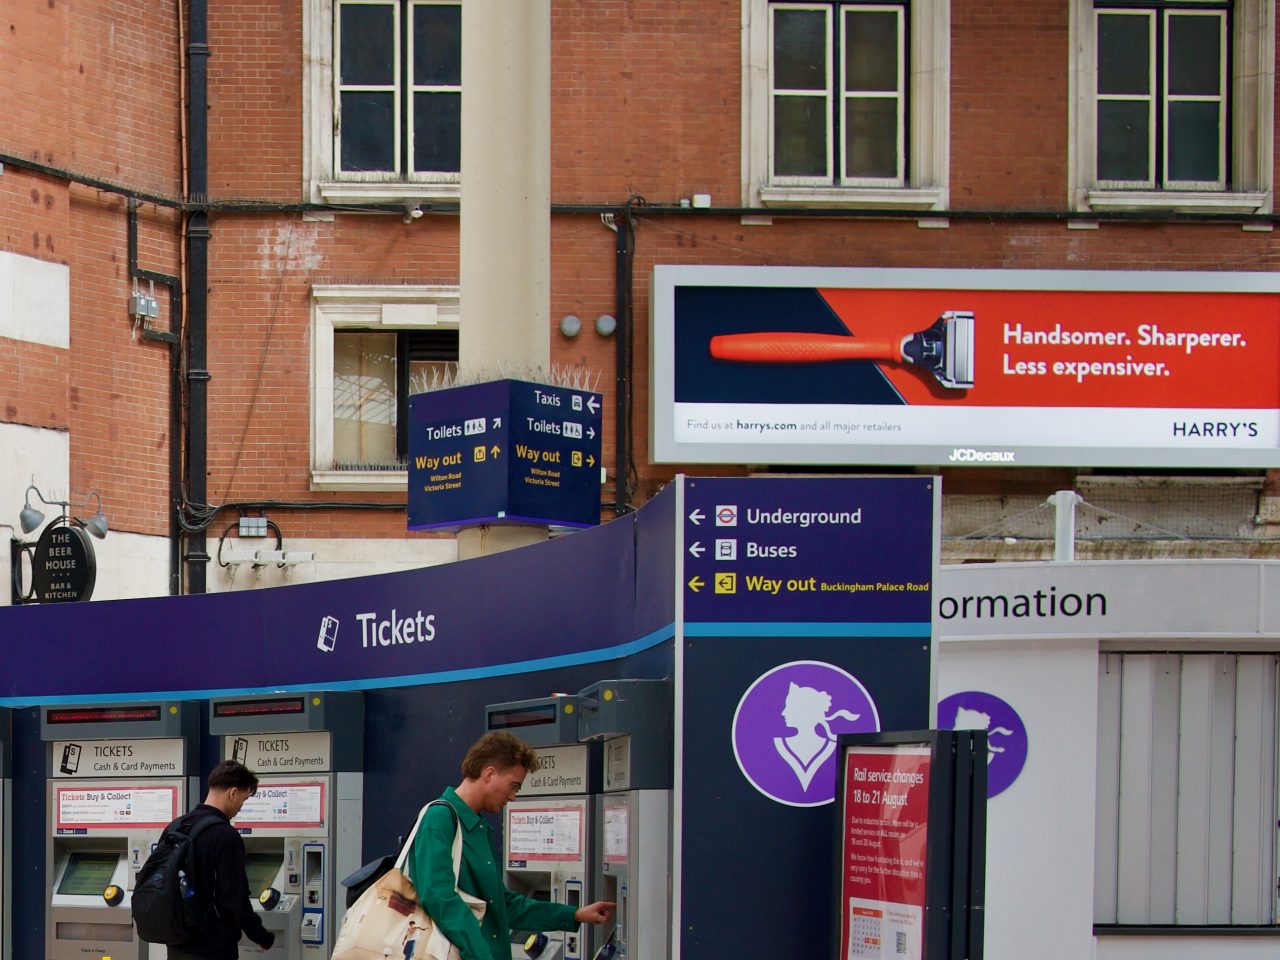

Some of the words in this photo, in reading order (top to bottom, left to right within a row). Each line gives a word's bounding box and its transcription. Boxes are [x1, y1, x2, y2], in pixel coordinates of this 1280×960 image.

[1002, 323, 1131, 346] Handsomer.
[1137, 324, 1247, 354] Sharperer.
[1002, 353, 1047, 375] Less
[1052, 355, 1171, 383] expensiver.
[534, 390, 561, 407] Taxis
[426, 424, 462, 441] Toilets
[527, 417, 561, 436] Toilets
[686, 419, 709, 430] Find
[711, 422, 722, 430] us
[724, 421, 734, 430] at
[736, 419, 797, 433] harrys.com
[800, 420, 817, 431] and
[820, 420, 831, 431] all
[833, 421, 861, 434] major
[863, 420, 902, 431] retailers
[1172, 421, 1259, 437] HARRY'S
[515, 444, 539, 463] Way
[542, 448, 561, 463] out
[948, 448, 1015, 463] JCDecaux
[415, 455, 439, 471] Way
[442, 452, 462, 466] out
[430, 473, 448, 482] Wilton
[448, 471, 462, 481] Road
[530, 467, 547, 476] Wilton
[547, 469, 561, 478] Road
[424, 483, 445, 493] Victoria
[445, 481, 462, 491] Street
[524, 476, 544, 486] Victoria
[545, 478, 561, 488] Street
[746, 507, 863, 527] Underground
[51, 534, 71, 544] THE
[49, 546, 73, 557] BEER
[746, 542, 798, 558] Buses
[45, 559, 77, 570] HOUSE
[50, 582, 66, 590] BAR
[745, 575, 782, 594] Way
[786, 576, 817, 592] out
[820, 581, 875, 593] Buckingham
[876, 582, 905, 592] Palace
[906, 582, 929, 592] Road
[45, 591, 78, 600] KITCHEN
[939, 586, 1107, 619] ormation
[355, 608, 436, 648] Tickets
[94, 745, 133, 757] TICKETS
[257, 740, 290, 752] TICKETS
[93, 762, 111, 771] Cash
[112, 762, 119, 771] &
[120, 762, 138, 771] Card
[140, 762, 176, 773] Payments
[257, 757, 272, 767] Cash
[273, 757, 278, 767] &
[279, 757, 294, 767] Card
[294, 756, 324, 768] Payments
[537, 755, 556, 769] KETS
[530, 777, 542, 788] Cash
[542, 776, 547, 787] &
[547, 775, 559, 787] Card
[559, 774, 582, 788] Payments
[854, 767, 867, 781] Rail
[868, 768, 892, 782] service
[893, 768, 924, 787] changes
[61, 793, 85, 801] Tickets
[86, 793, 99, 802] Buy
[100, 793, 106, 801] &
[106, 792, 131, 801] Collect
[262, 790, 267, 798] &
[267, 790, 288, 798] Collect
[853, 789, 861, 803] 18
[862, 790, 871, 804] to
[871, 790, 880, 804] 21
[881, 790, 908, 809] August
[526, 815, 535, 826] Buy
[538, 815, 554, 825] Collect
